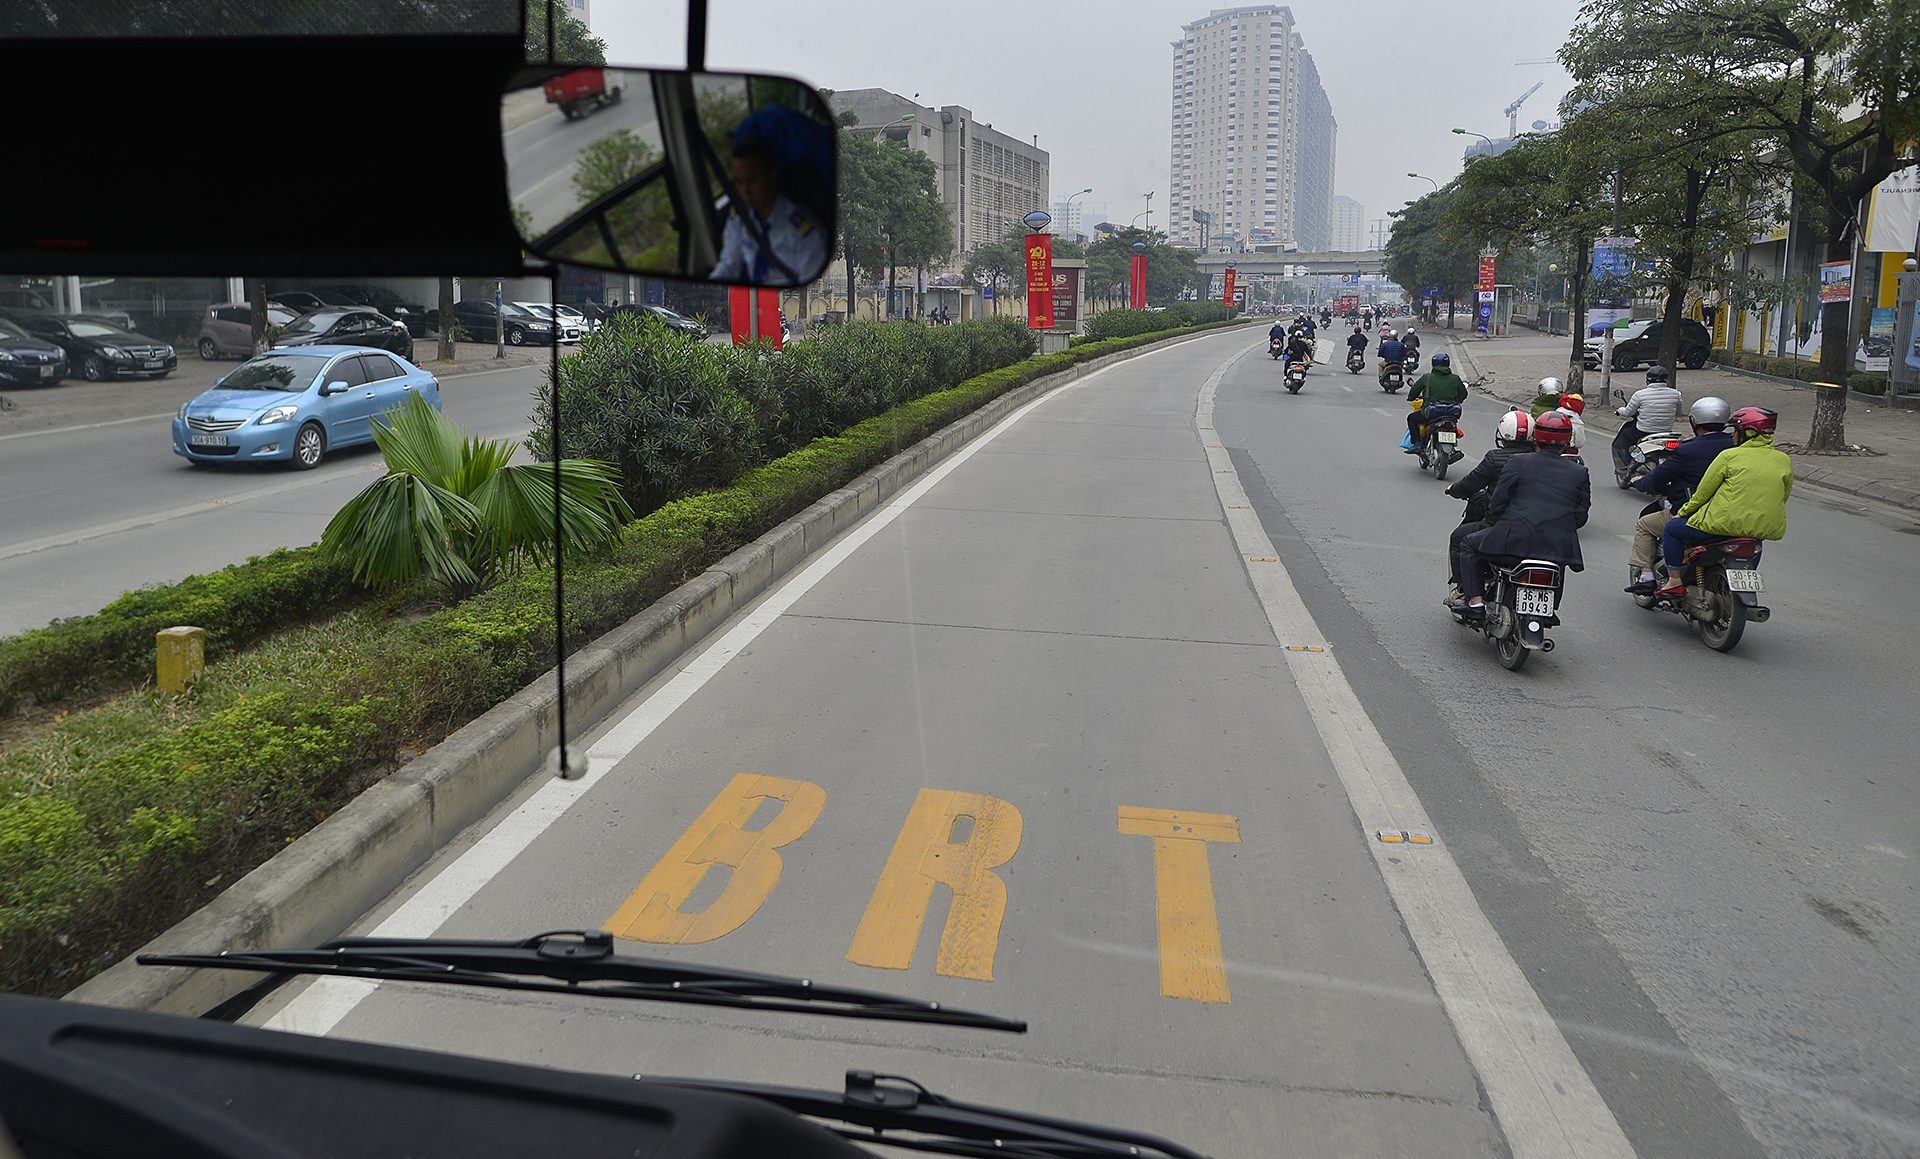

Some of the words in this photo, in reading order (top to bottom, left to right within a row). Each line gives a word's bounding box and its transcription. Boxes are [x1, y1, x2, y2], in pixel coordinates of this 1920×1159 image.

[1732, 571, 1758, 580] 30-F9
[1521, 601, 1548, 614] 0943
[600, 772, 1243, 1005] BRT
